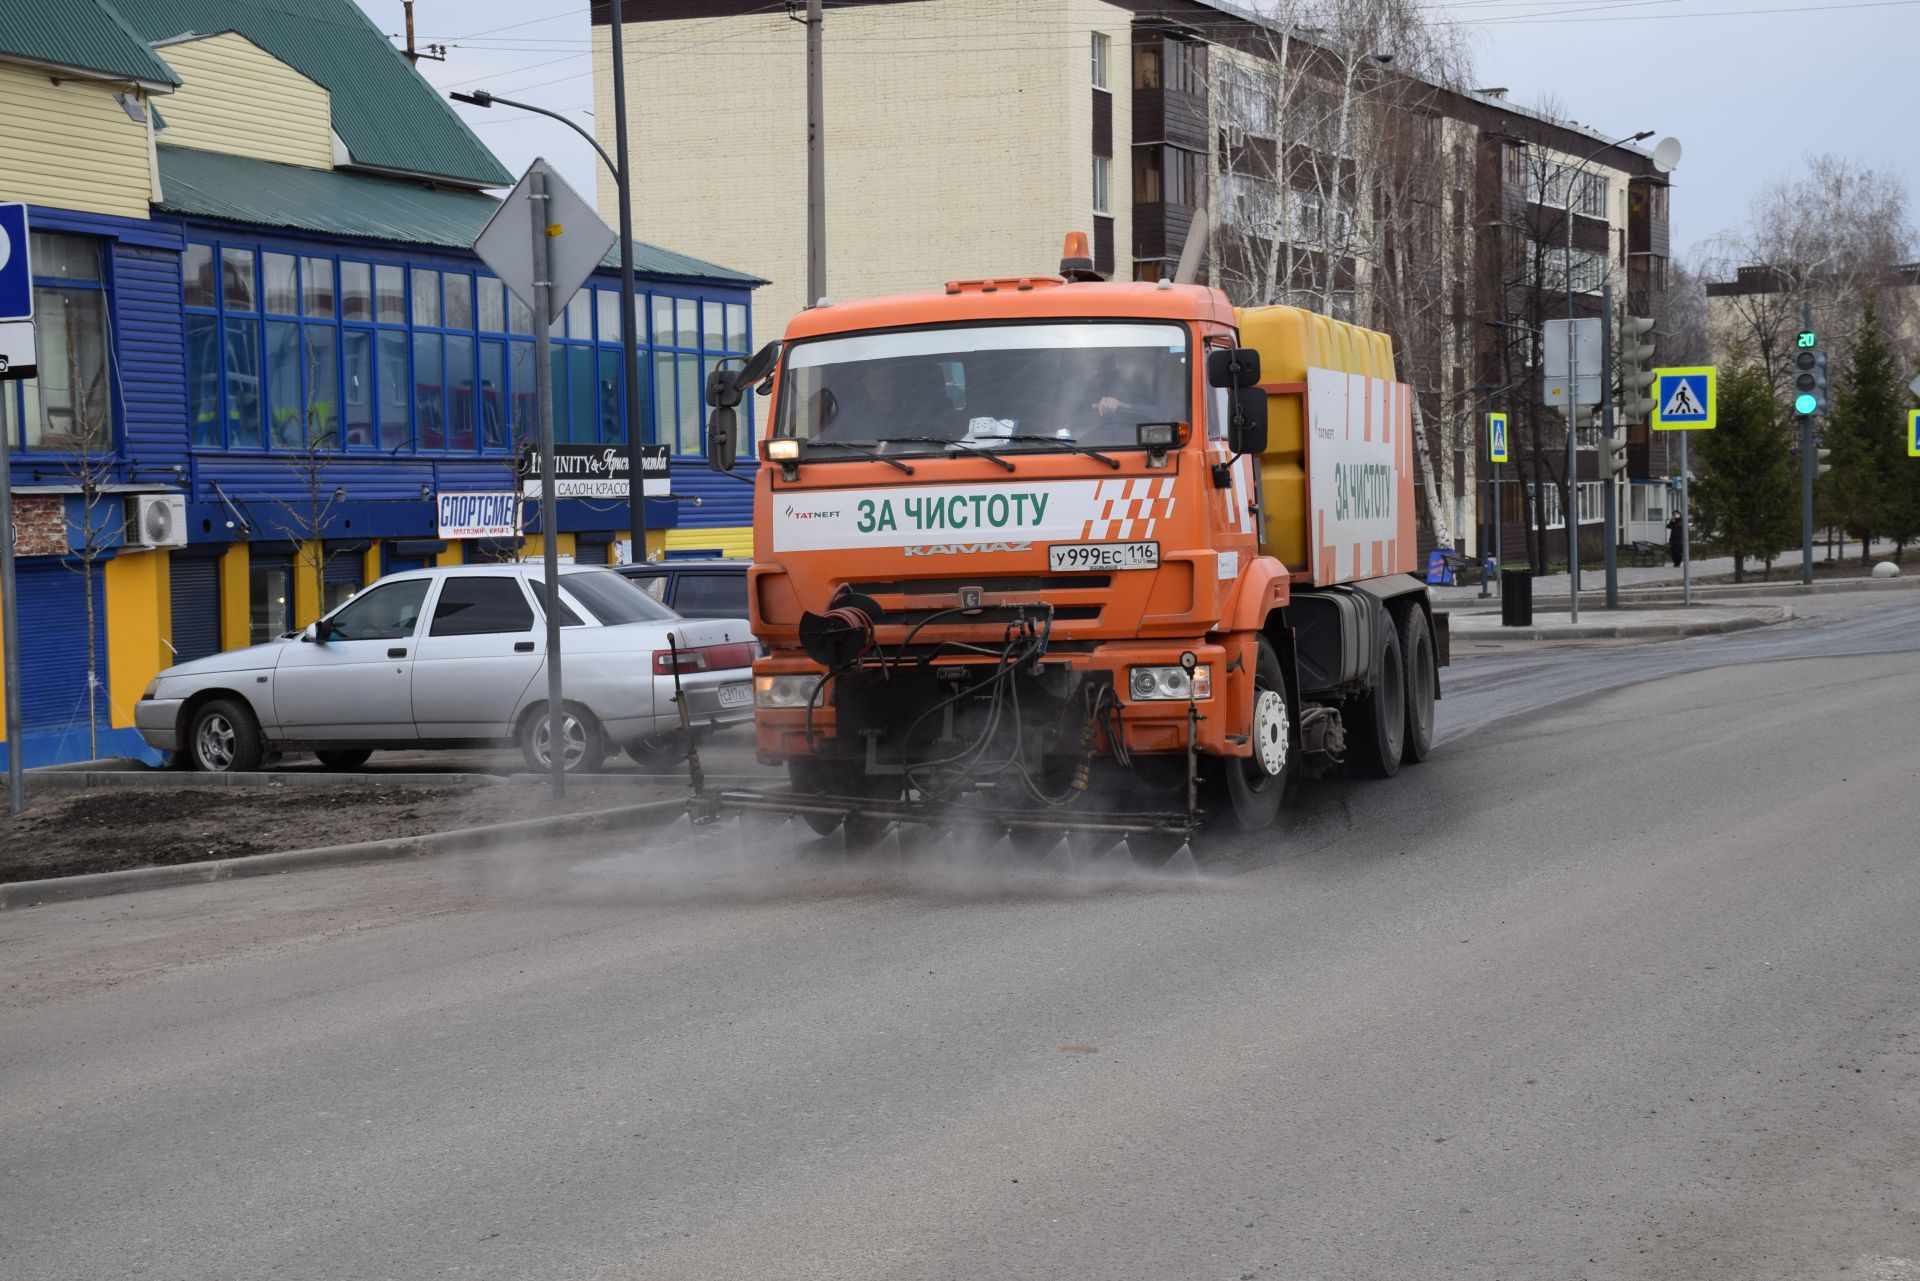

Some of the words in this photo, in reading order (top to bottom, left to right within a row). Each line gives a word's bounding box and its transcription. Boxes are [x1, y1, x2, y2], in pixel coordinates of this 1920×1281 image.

[1798, 333, 1815, 347] 20
[558, 482, 593, 496] САЛОН
[595, 481, 630, 495] КРАСО
[1335, 462, 1349, 522] ЗА
[1350, 463, 1391, 520] ЧИСТОТУ
[794, 510, 841, 519] TATNEFT
[856, 499, 898, 533] ЗА
[904, 492, 1049, 530] ЧИСТОТУ
[1128, 545, 1153, 559] 116
